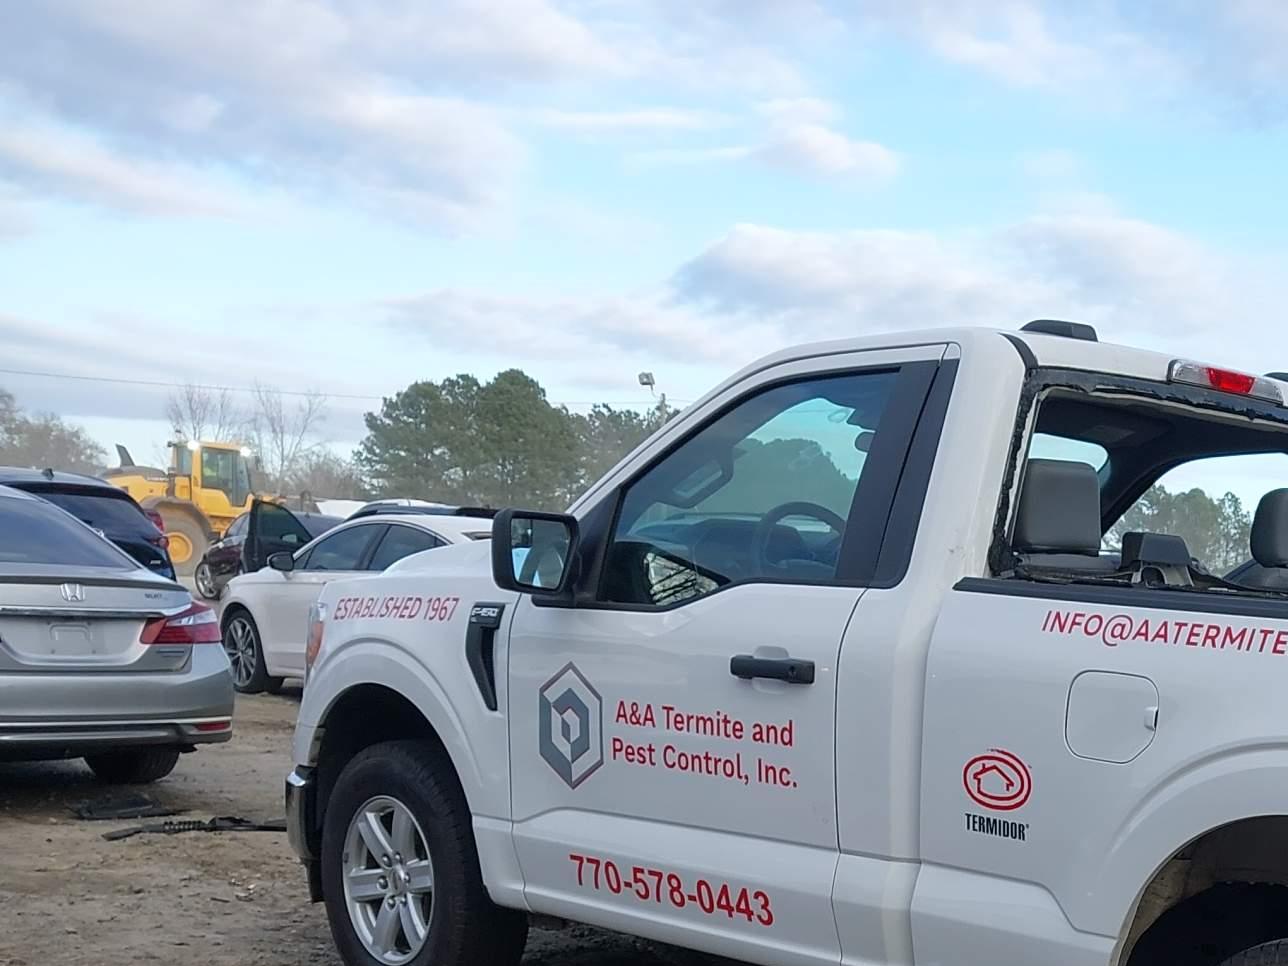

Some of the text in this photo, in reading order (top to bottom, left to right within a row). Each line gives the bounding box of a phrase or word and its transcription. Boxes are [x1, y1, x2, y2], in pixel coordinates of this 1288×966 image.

[333, 597, 459, 622] ESTABLISHED 1967
[615, 701, 794, 748] A&A Termite and
[612, 738, 798, 788] Pest Control, Inc.
[570, 853, 775, 928] 770-578-0443
